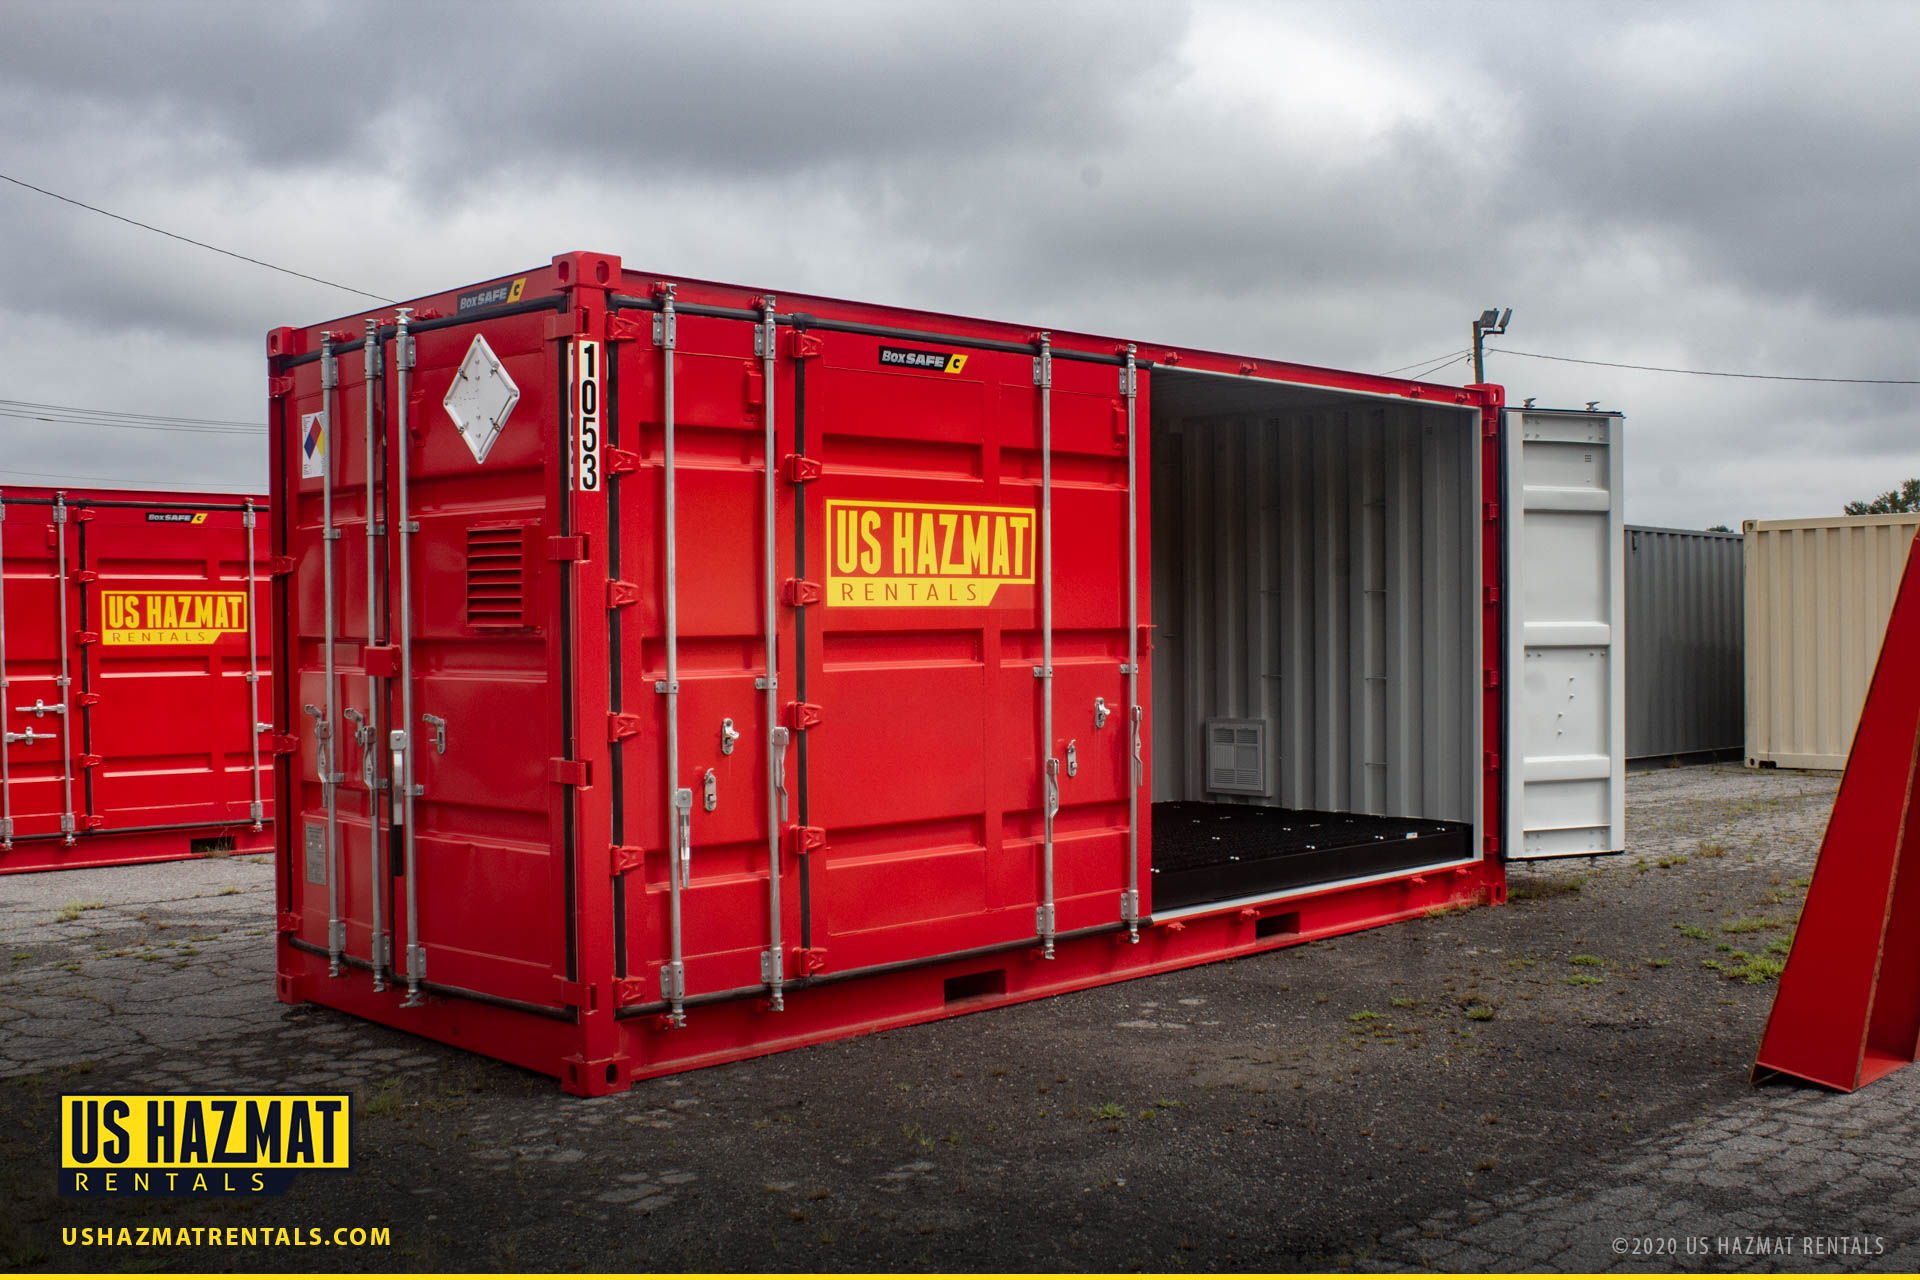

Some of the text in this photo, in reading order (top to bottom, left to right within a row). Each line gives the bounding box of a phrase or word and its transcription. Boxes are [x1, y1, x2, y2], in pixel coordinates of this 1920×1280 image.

[460, 287, 508, 310] BoxSAFE
[881, 350, 961, 369] BoxSAFE C
[582, 343, 597, 490] 1053
[837, 509, 1029, 576] US HAZMAT
[841, 582, 977, 601] RENTALS
[108, 595, 242, 629] US HAZMAT
[112, 631, 206, 643] RENTALS
